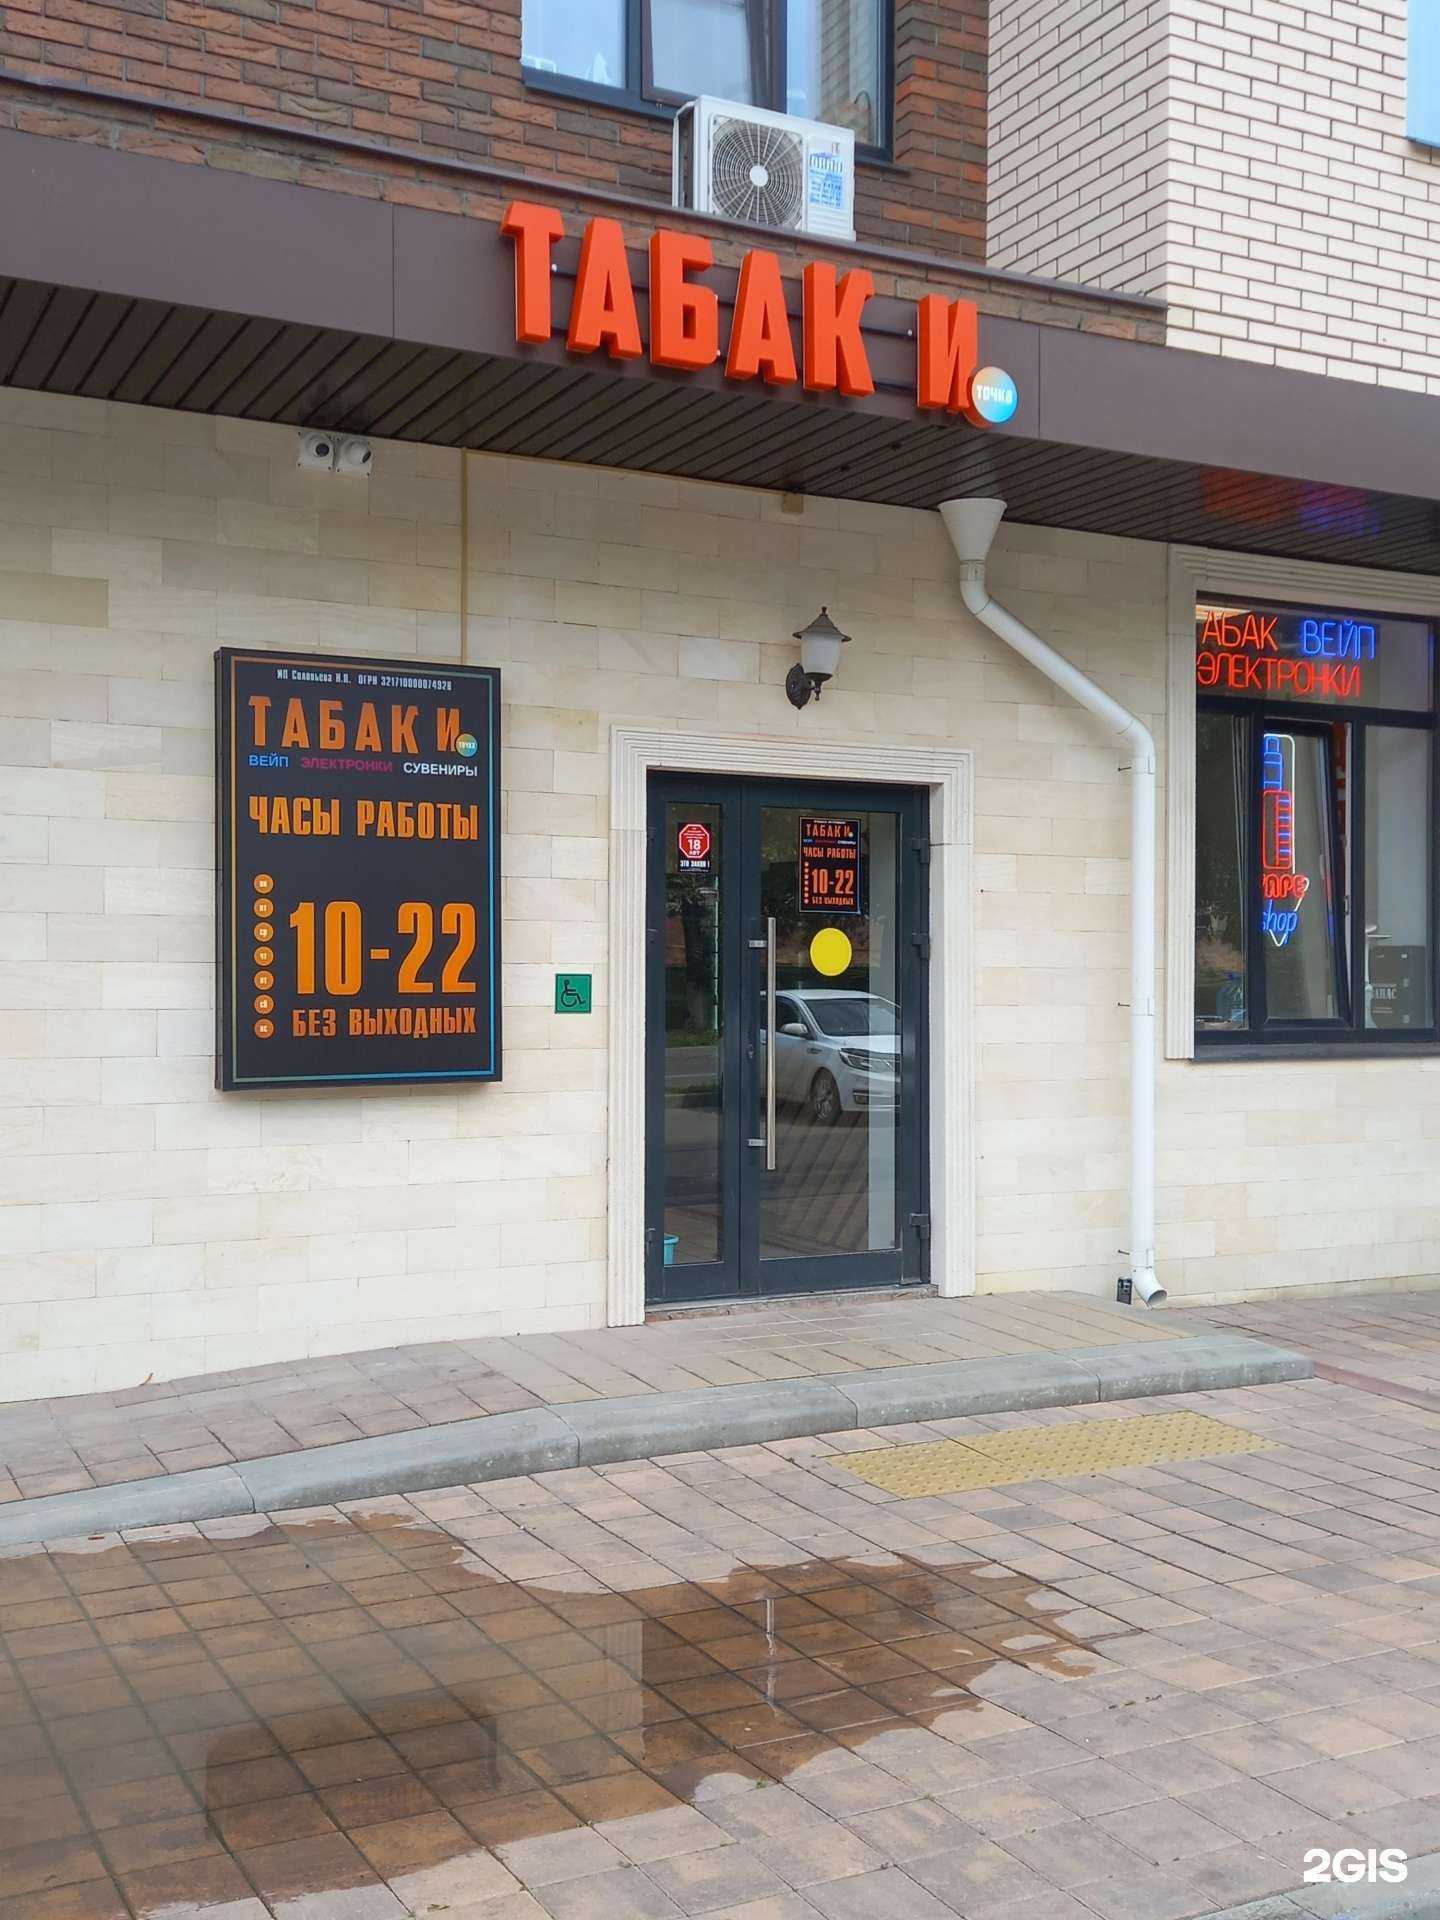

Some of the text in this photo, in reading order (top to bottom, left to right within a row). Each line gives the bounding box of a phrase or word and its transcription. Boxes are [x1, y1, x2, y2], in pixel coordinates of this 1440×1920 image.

[500, 201, 876, 397] ТАБАК
[917, 293, 979, 414] И
[1202, 611, 1375, 660] АБАК ВЕЙП
[277, 669, 288, 680] ИП
[358, 674, 378, 686] ОГРН
[1197, 651, 1360, 698] ЭЛЕКТРОНКИ
[248, 695, 420, 754] ТАБАК
[436, 707, 460, 752] И
[248, 752, 478, 777] ВЕЙП ЭЛЕКТРОНКИ СУВЕНИРЫ
[249, 796, 478, 840] ЧАСЫ РАБОТЫ
[806, 823, 841, 837] ТАБАК
[687, 839, 701, 850] 18
[803, 846, 857, 860] ЧАСЫ РАБОТЫ
[811, 868, 854, 895] 10-22
[289, 901, 476, 996] 10-22
[292, 1007, 476, 1039] БЕЗ ВЫХОДНЫХ
